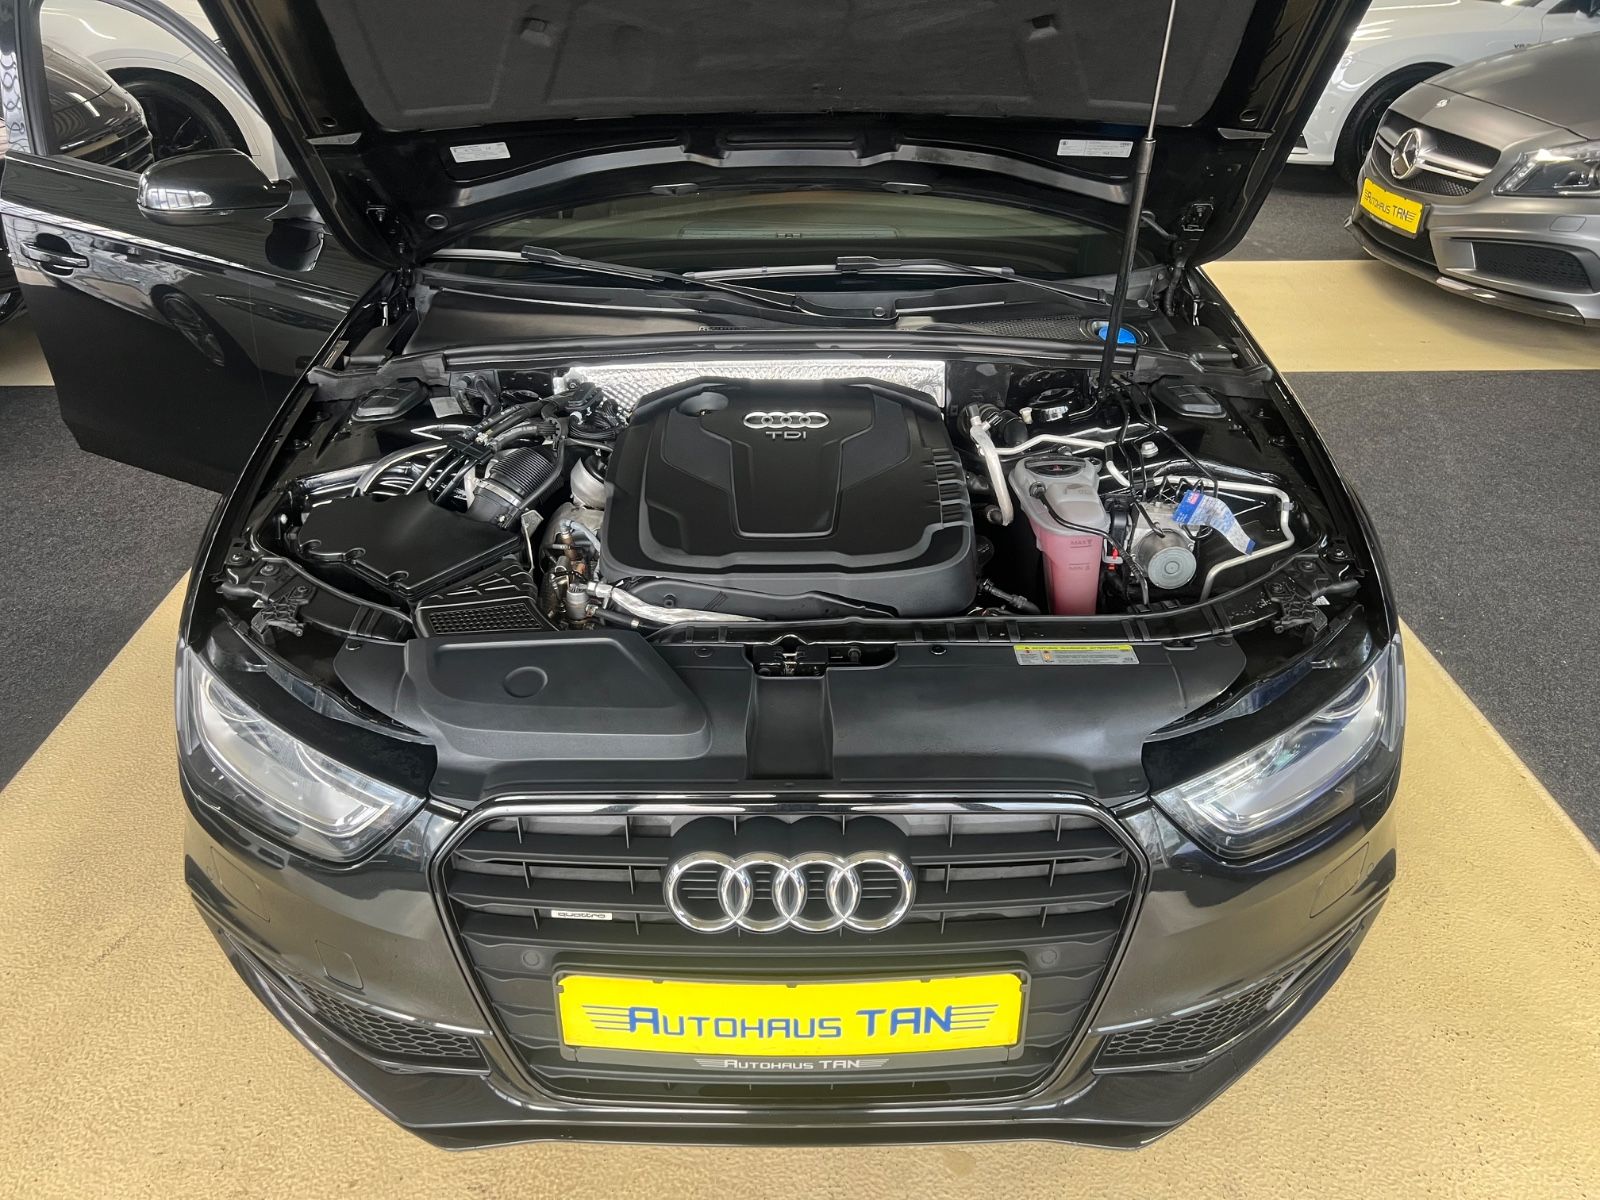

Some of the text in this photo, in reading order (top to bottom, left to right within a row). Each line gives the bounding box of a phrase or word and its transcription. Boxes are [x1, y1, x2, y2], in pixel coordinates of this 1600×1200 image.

[1367, 191, 1408, 221] AUTOHAUS TAN
[765, 431, 807, 439] TDI
[628, 1004, 952, 1039] AUTOHAUS TAN
[724, 1059, 861, 1070] AUTOHAUS TAN
